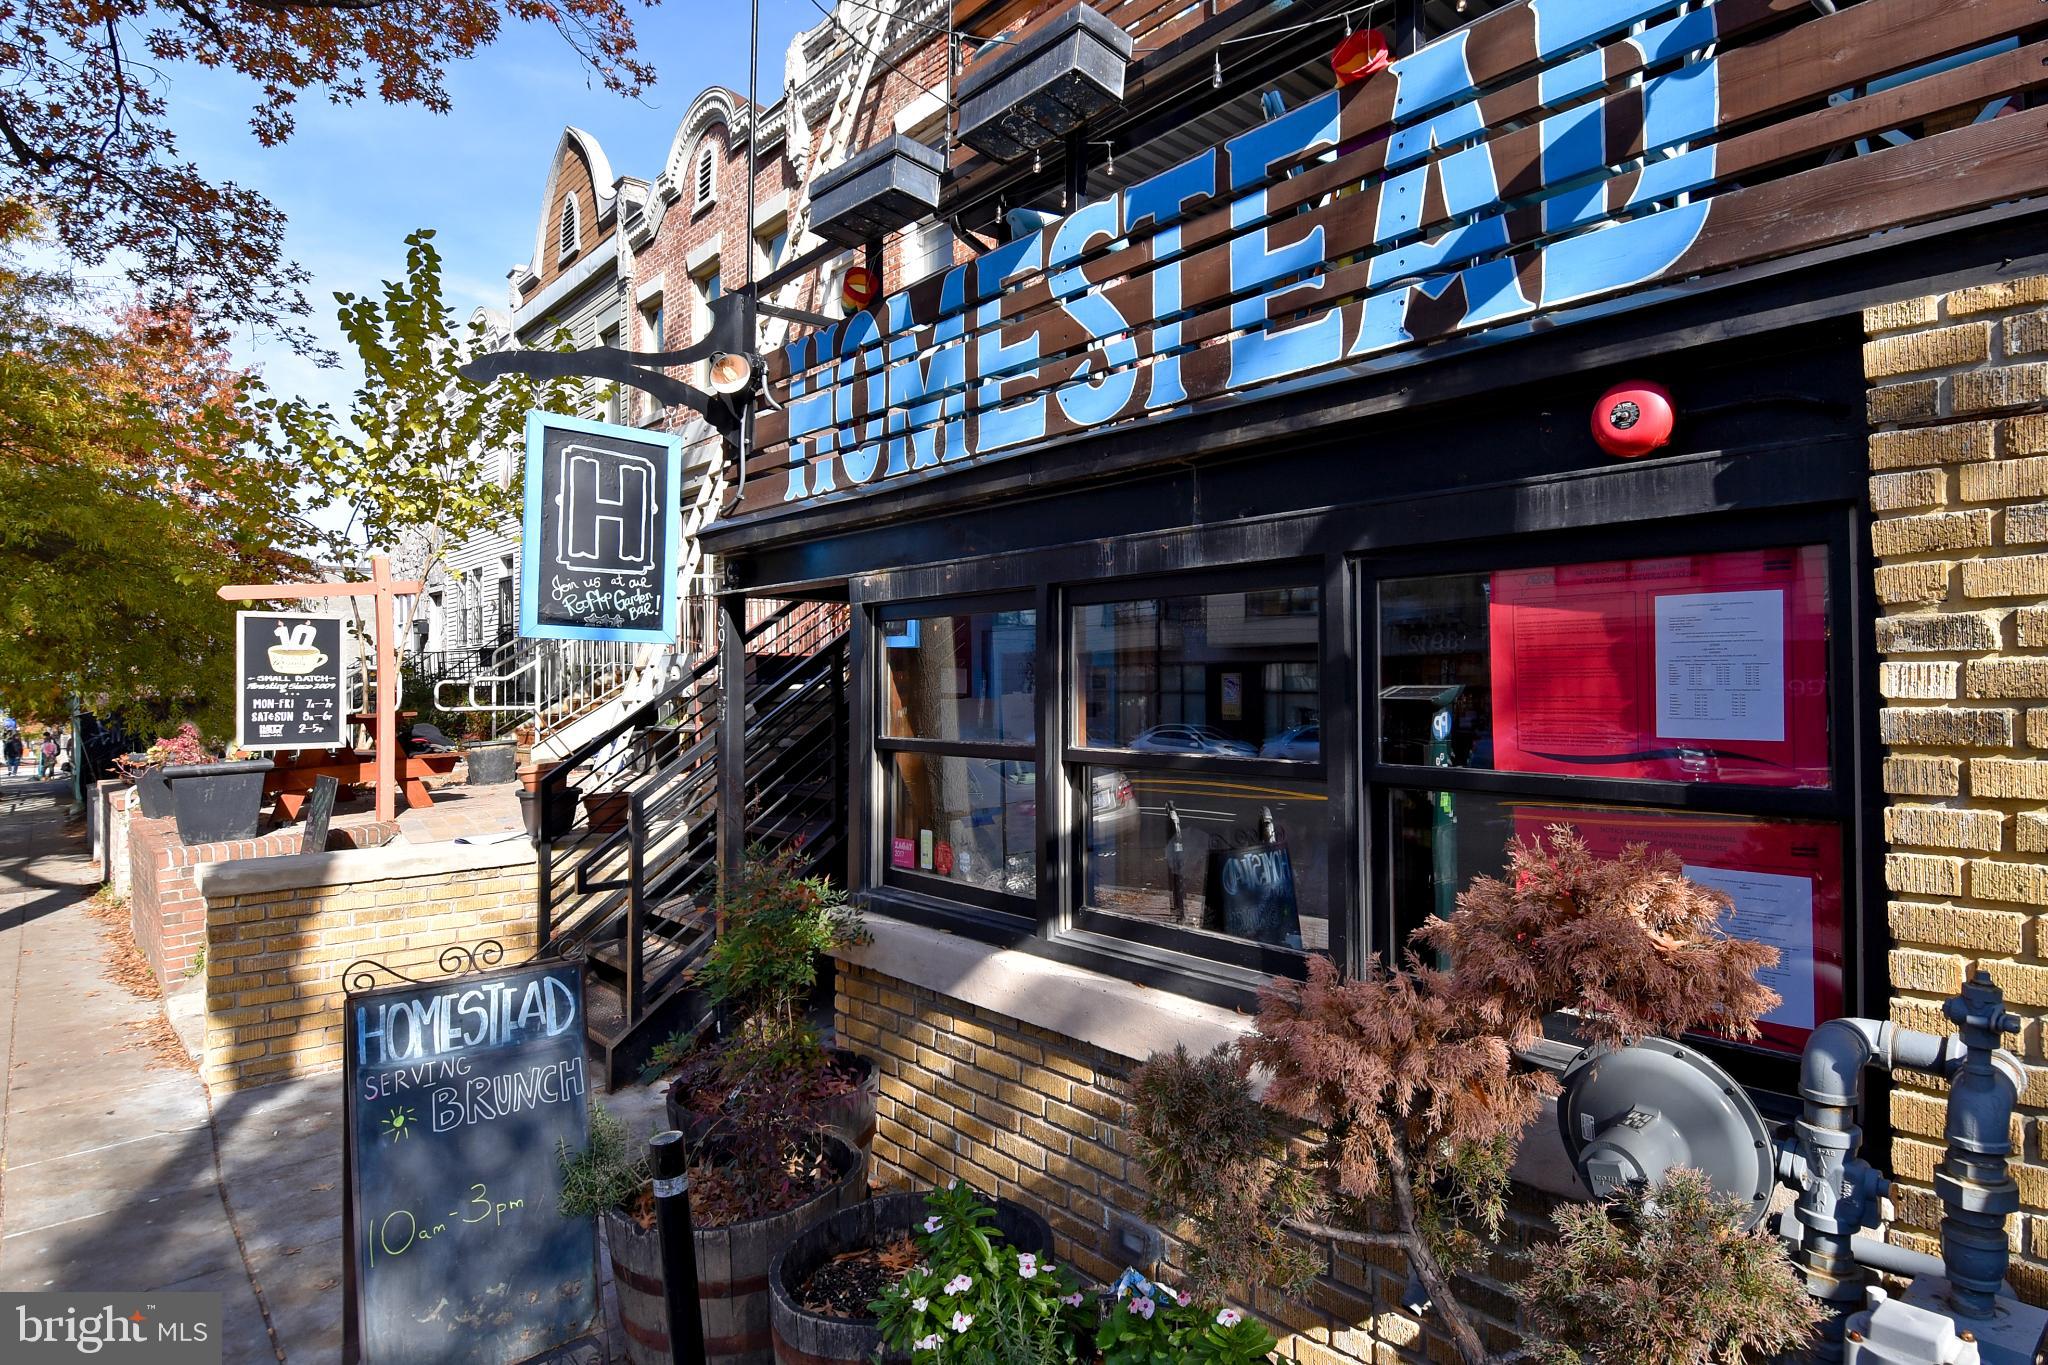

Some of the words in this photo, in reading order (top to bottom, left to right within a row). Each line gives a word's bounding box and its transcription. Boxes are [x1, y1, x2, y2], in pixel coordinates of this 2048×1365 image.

[784, 0, 1719, 503] HOMESTEAD
[568, 456, 647, 561] H
[551, 574, 579, 601] Join
[583, 577, 601, 588] us
[611, 573, 626, 587] at
[613, 588, 654, 612] Garden
[273, 624, 317, 651] 10
[252, 699, 295, 709] MON-FRI
[894, 841, 913, 851] ZAGAT
[357, 976, 576, 1065] HOMESTEAD
[364, 1056, 472, 1101] SERVING
[432, 1057, 585, 1133] BRUNCH
